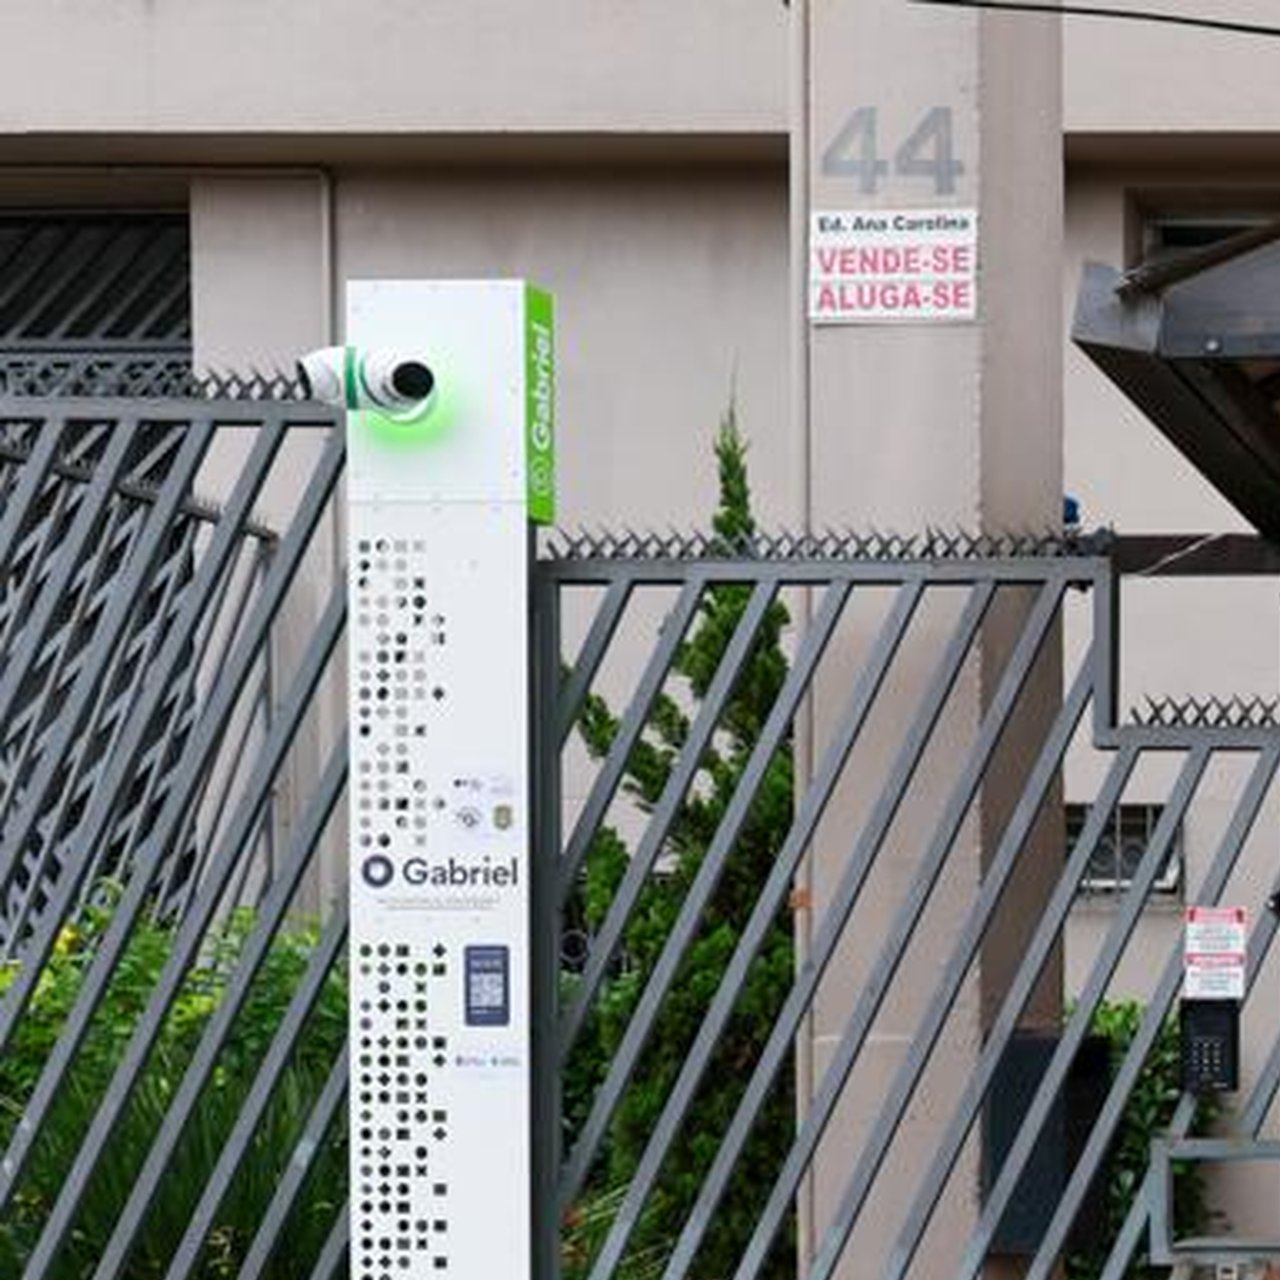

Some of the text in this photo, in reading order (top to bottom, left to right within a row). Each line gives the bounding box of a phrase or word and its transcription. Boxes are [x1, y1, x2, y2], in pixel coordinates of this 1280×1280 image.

[820, 105, 966, 196] 44
[818, 215, 970, 233] Ed. Ana Carolina
[818, 245, 971, 275] VENDE-SE
[818, 280, 971, 311] ALUGA-SE
[532, 320, 551, 451] Gabriel
[402, 854, 518, 886] Gabriel
